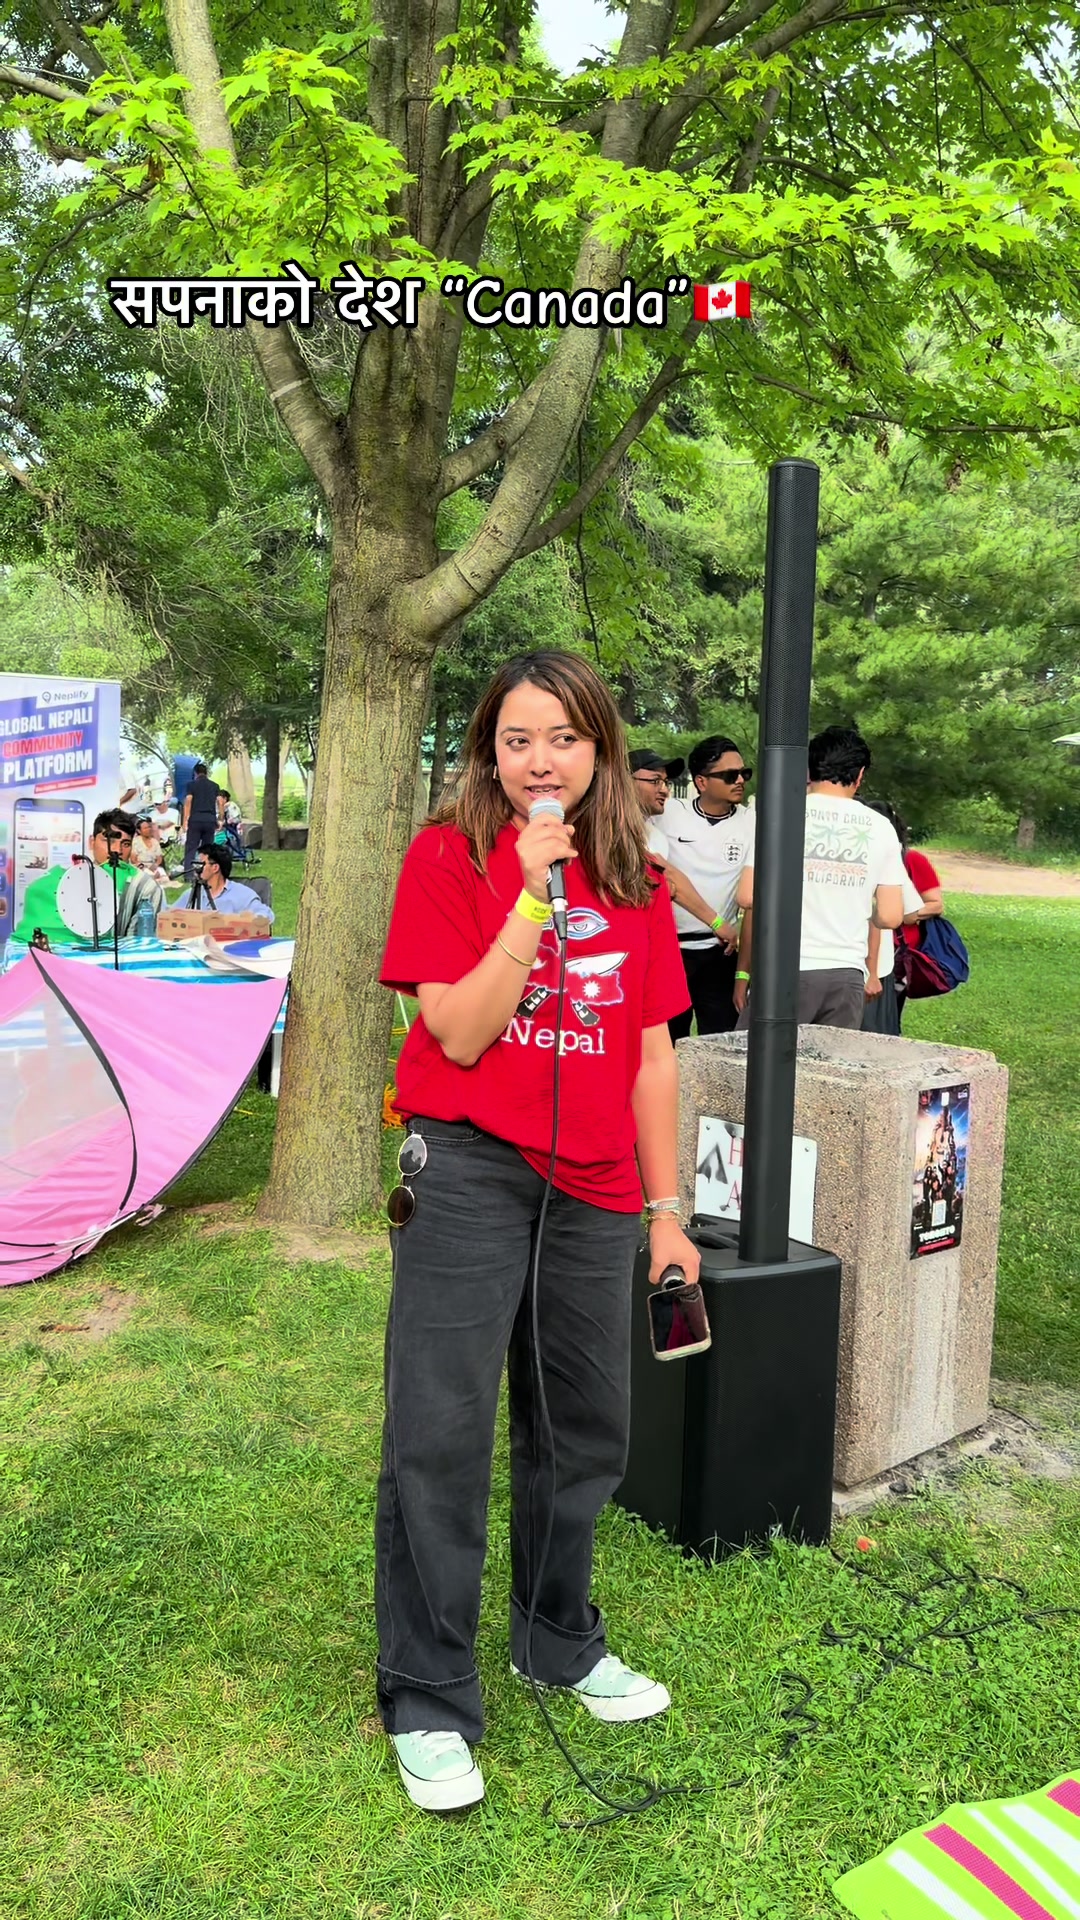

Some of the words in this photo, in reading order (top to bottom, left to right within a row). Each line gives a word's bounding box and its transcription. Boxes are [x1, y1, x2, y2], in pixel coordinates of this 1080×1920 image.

[54, 690, 88, 701] Neplify
[0, 714, 45, 736] GLOBAL
[48, 706, 93, 729] NEPALI
[3, 730, 84, 758] COMMUNITY
[3, 749, 93, 783] PLATFORM
[843, 813, 873, 827] CRUZ
[804, 871, 866, 887] ALIFORNIA
[501, 1018, 606, 1056] Nepal
